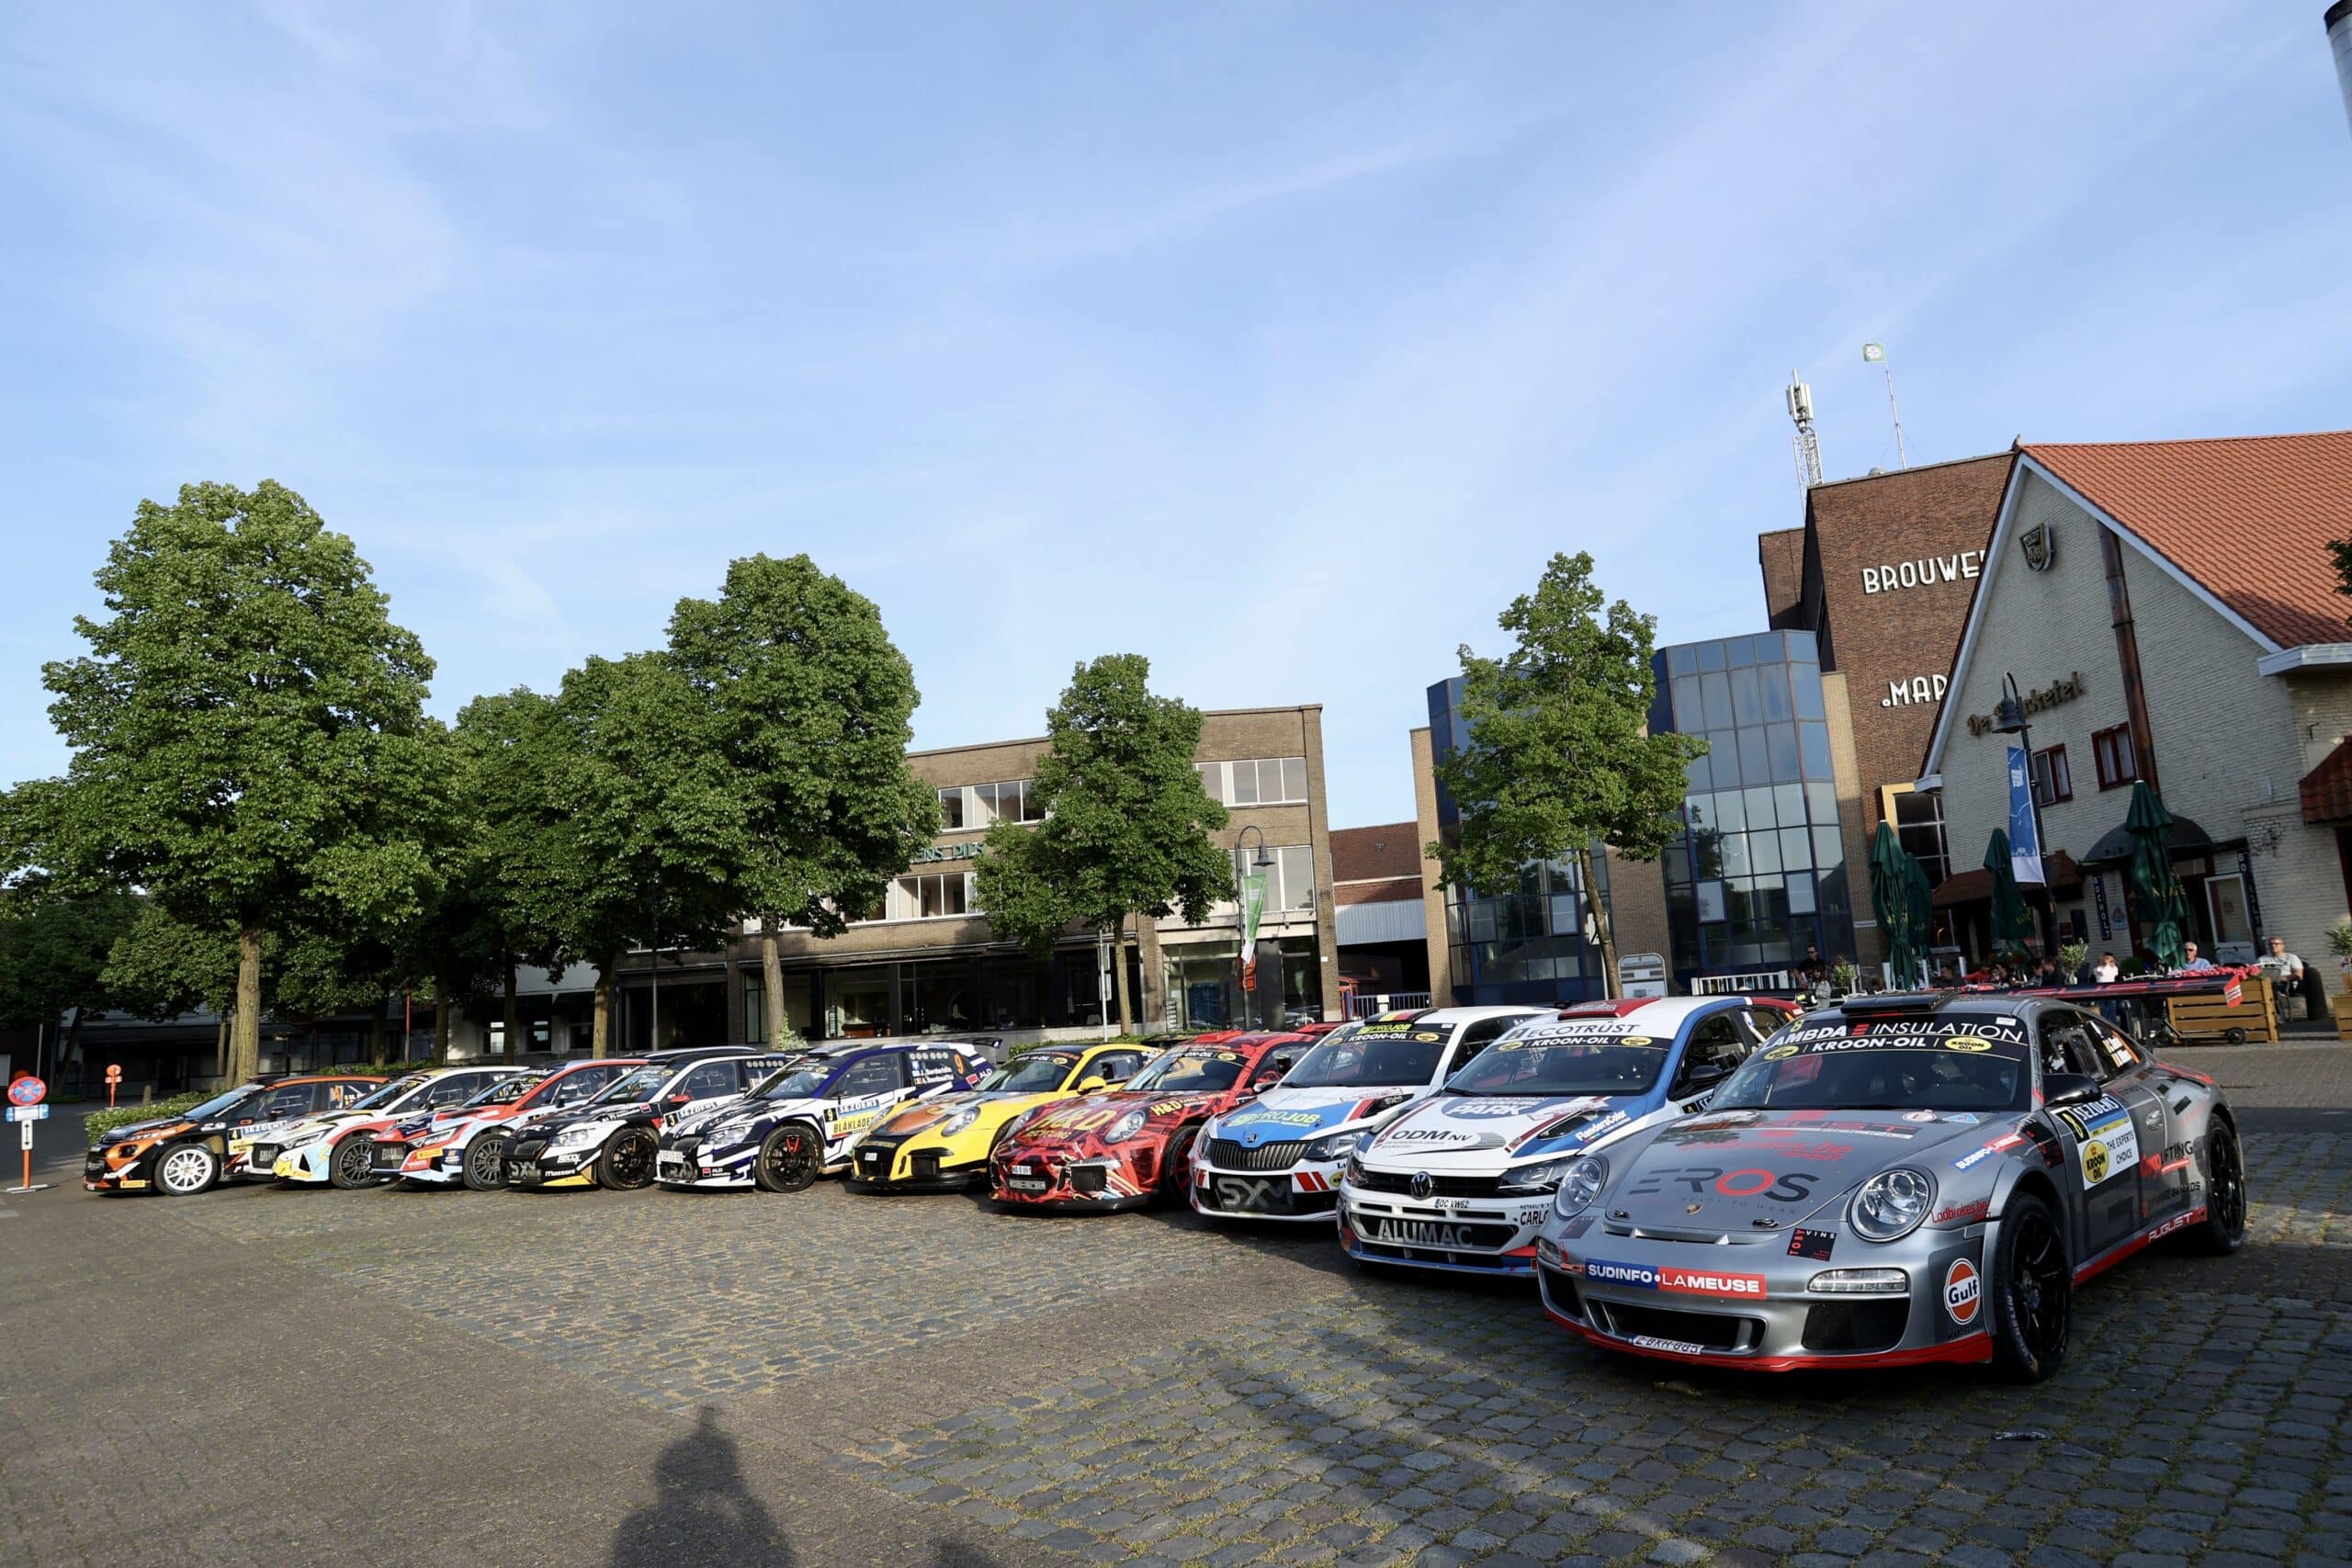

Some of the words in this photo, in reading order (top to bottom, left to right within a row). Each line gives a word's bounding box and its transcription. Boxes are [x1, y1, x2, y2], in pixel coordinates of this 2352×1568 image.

[1862, 550, 1986, 594] BROUWE
[1790, 1019, 1805, 1032] 8
[1348, 1032, 1407, 1043] KROON-OIL
[1532, 1036, 1609, 1047] KROON-OIL
[1762, 1025, 1848, 1052] LAMBDA
[1871, 1021, 2023, 1043] INSULATION
[1812, 1037, 1927, 1052] KROON-OIL
[954, 1054, 966, 1075] 9
[978, 1067, 992, 1080] ALD
[828, 1110, 834, 1122] 9
[1150, 1100, 1182, 1116] H&D
[1445, 1104, 1529, 1115] PARK
[2072, 1097, 2120, 1121] SEZOENS
[669, 1114, 675, 1125] 3
[232, 1130, 238, 1140] 4
[1391, 1130, 1453, 1140] ODM
[2086, 1153, 2106, 1171] KROON
[2116, 1148, 2133, 1165] CHOICE
[1628, 1168, 1820, 1202] EROS
[1378, 1219, 1474, 1247] ALUMAC
[2149, 1212, 2194, 1242] AUGUST
[1588, 1264, 1653, 1283] SUDINFO
[1949, 1280, 1978, 1304] Gulf
